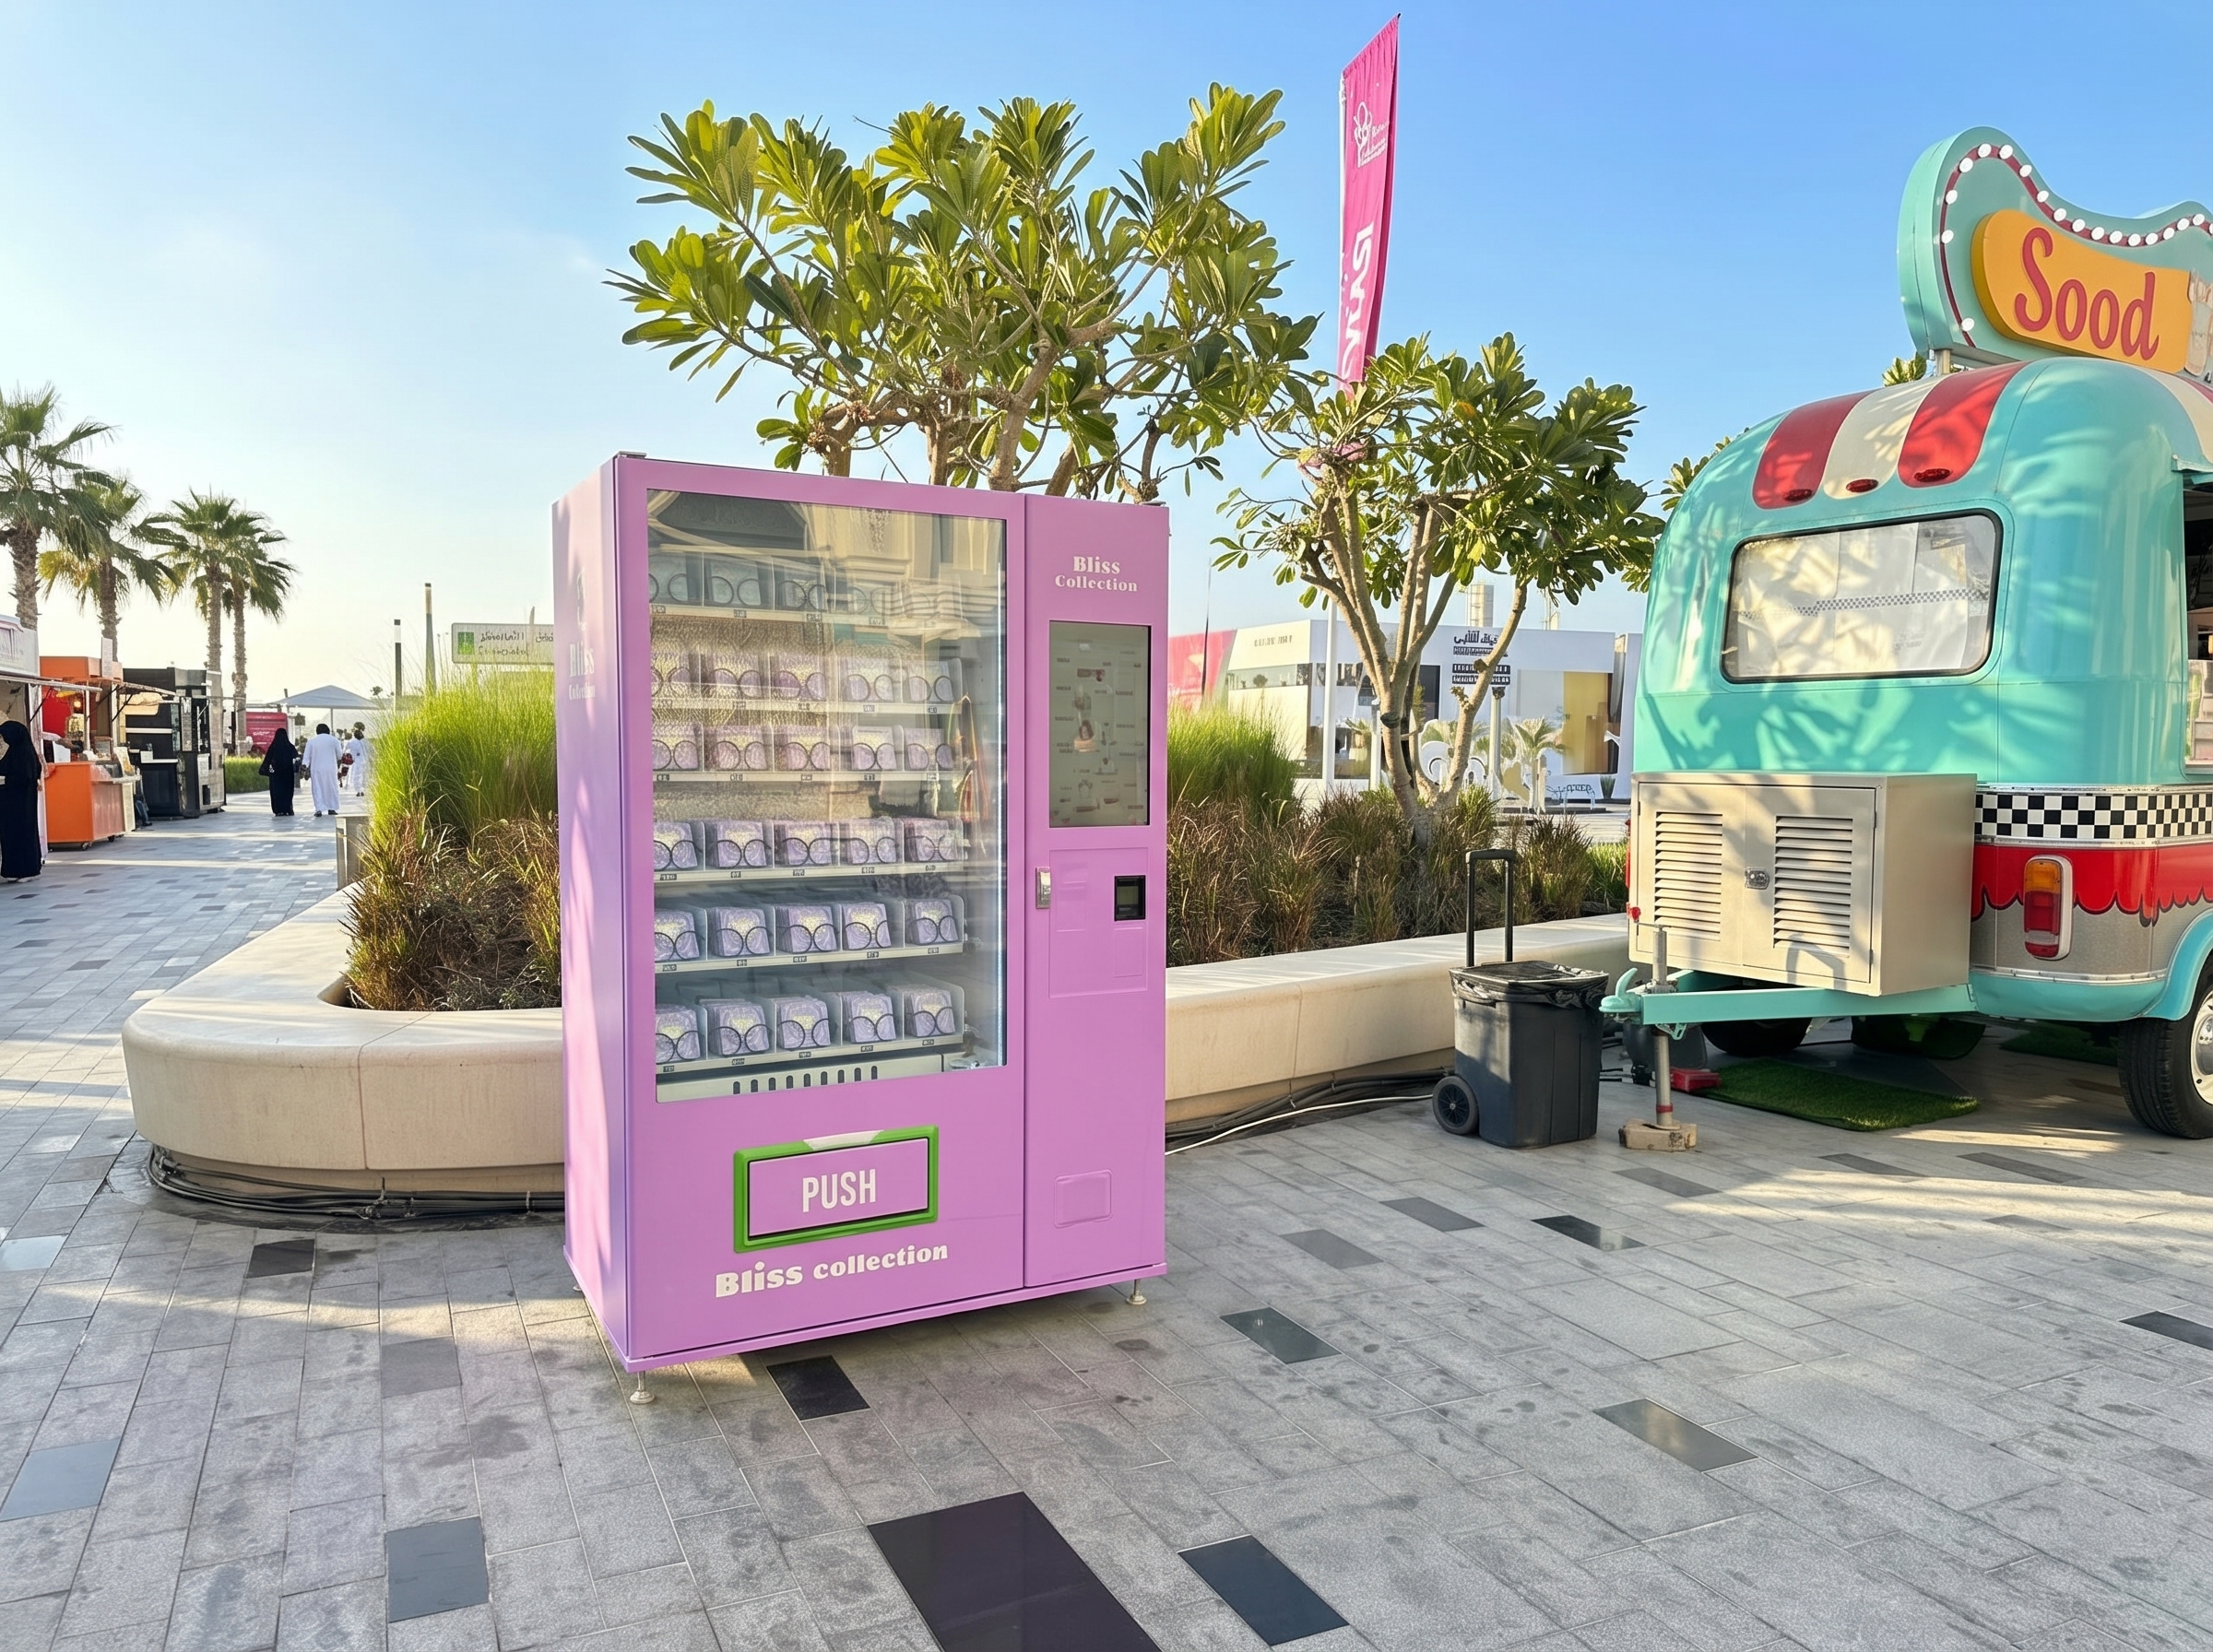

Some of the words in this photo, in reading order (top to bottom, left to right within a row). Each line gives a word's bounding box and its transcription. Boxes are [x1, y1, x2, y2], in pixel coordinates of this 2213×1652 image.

[2014, 227, 2160, 361] Sood
[1055, 574, 1138, 592] Collection
[1072, 556, 1120, 574] Bliss
[569, 641, 595, 678] Bliss
[802, 1169, 876, 1213] PUSH
[716, 1261, 803, 1298] Bliss
[812, 1245, 949, 1280] collection
